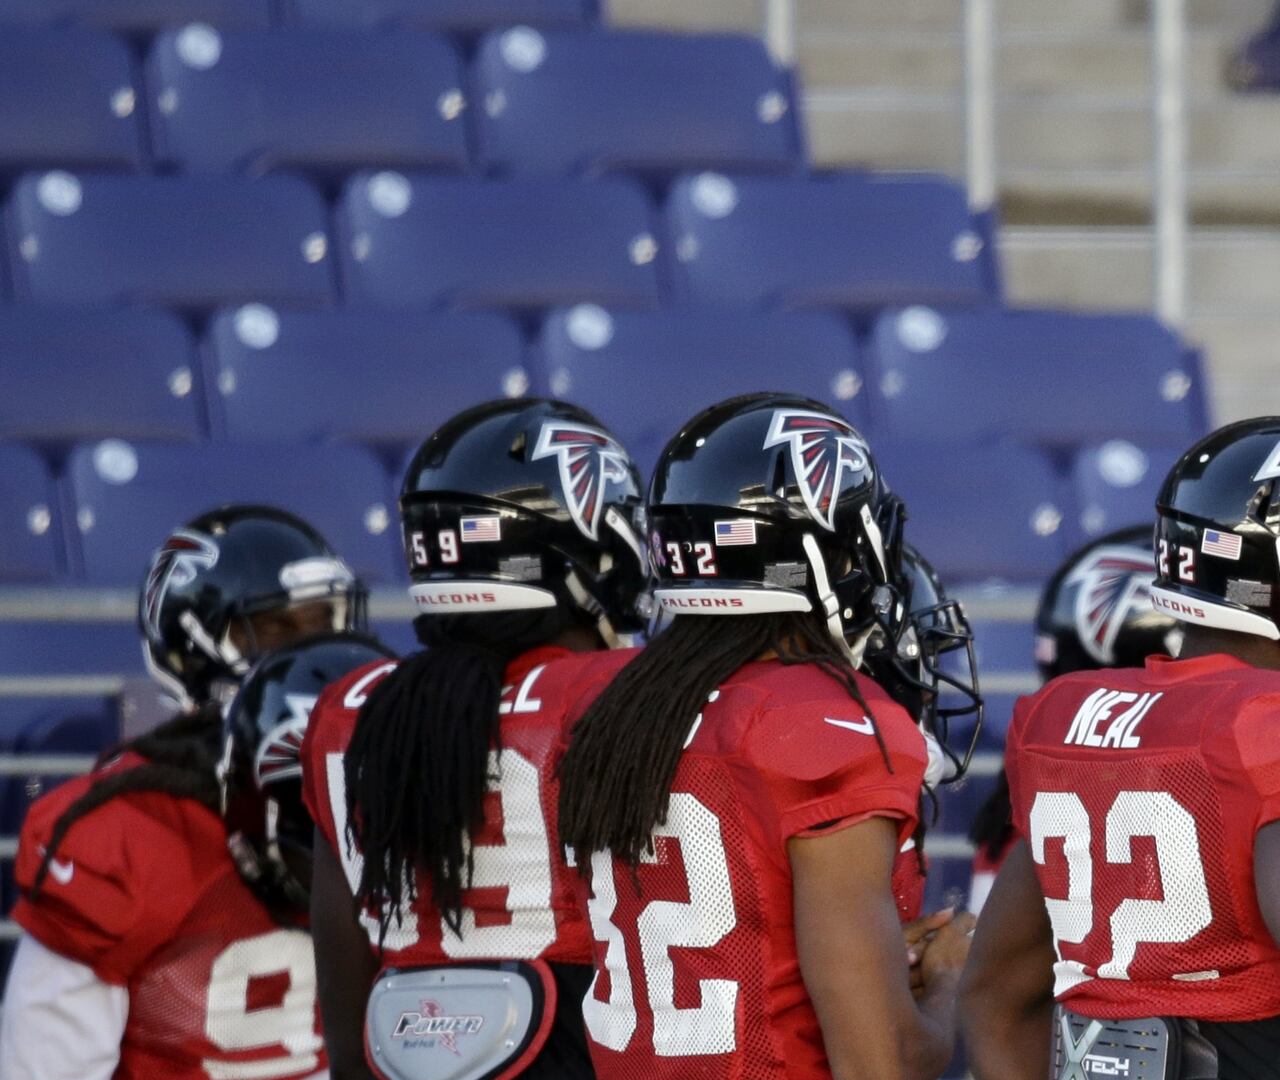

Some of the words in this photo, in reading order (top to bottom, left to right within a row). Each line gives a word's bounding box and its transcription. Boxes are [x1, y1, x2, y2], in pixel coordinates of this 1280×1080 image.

[411, 529, 460, 566] 59
[666, 542, 718, 577] 32
[1159, 538, 1196, 583] 22
[660, 598, 743, 608] FALCONS
[1064, 687, 1164, 749] NEAL
[392, 1012, 484, 1038] POWER
